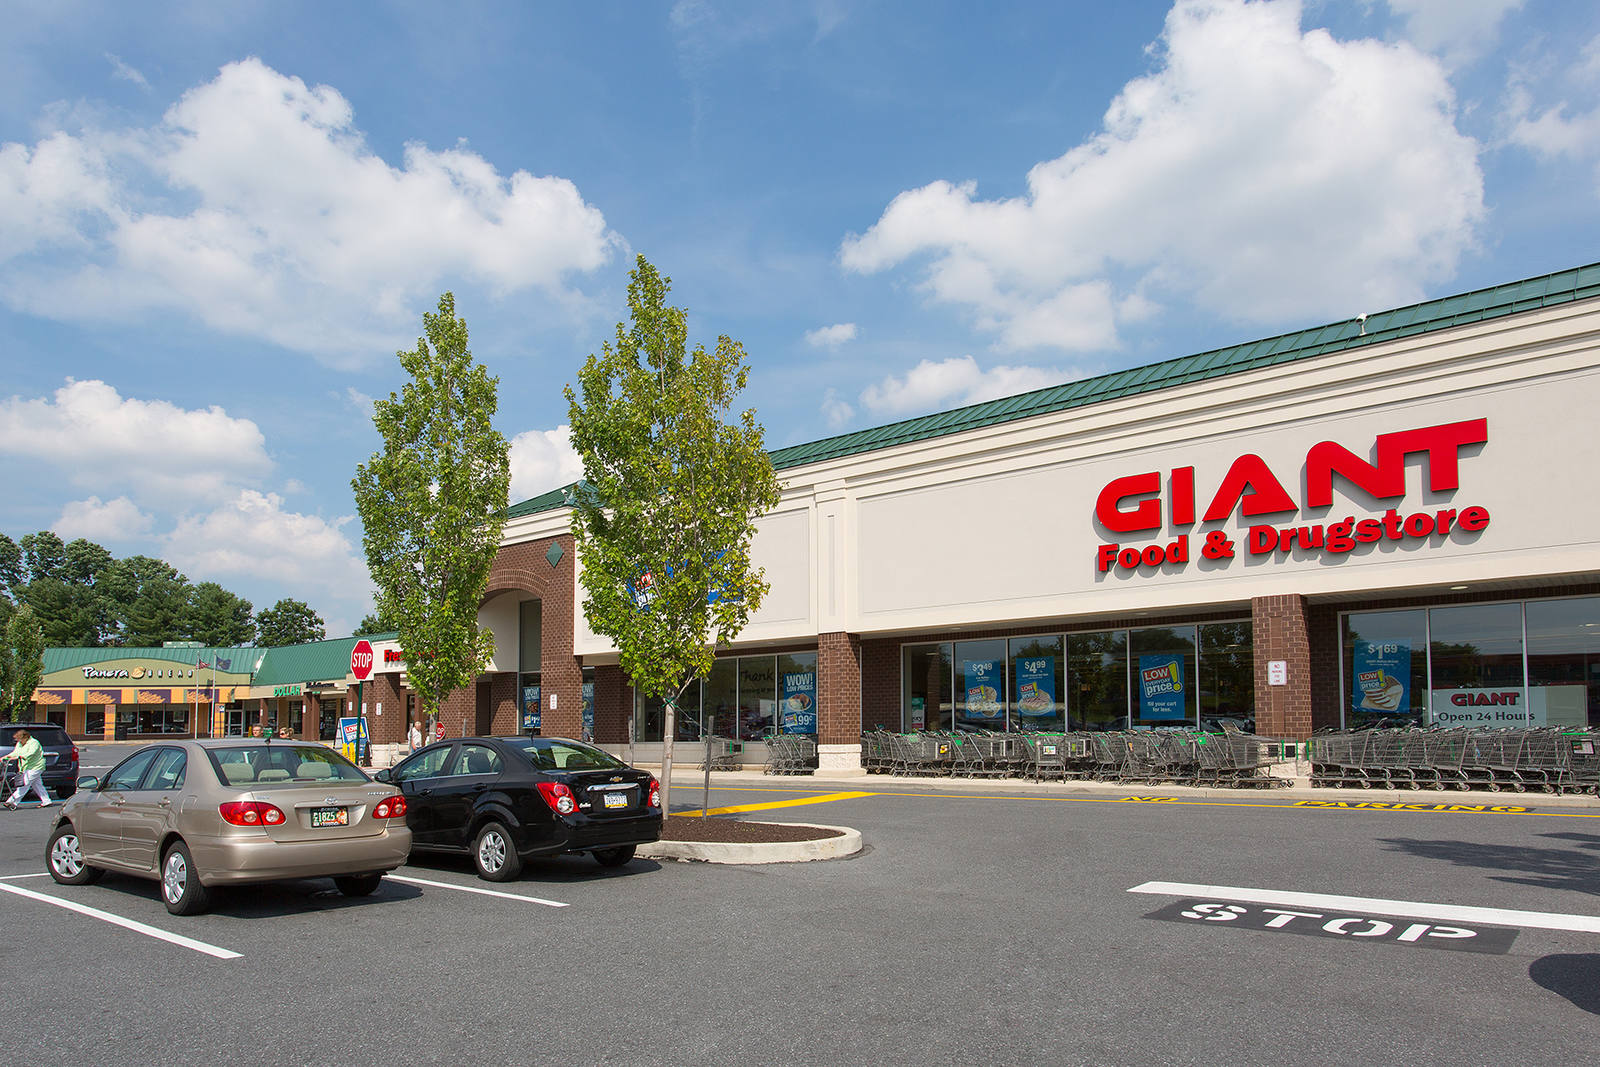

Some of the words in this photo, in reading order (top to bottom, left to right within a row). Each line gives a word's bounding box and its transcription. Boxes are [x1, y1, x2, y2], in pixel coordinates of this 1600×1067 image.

[1096, 418, 1488, 532] GIANT
[1098, 535, 1189, 571] Food
[1201, 530, 1235, 560] &
[1249, 505, 1490, 555] Drugstore
[353, 652, 372, 668] STOP
[82, 666, 129, 679] Panera
[147, 669, 194, 678] BREAD
[1144, 667, 1169, 681] LOW
[1359, 672, 1378, 681] LOW
[786, 673, 813, 687] WOW!
[273, 685, 301, 697] DOLLAR
[1451, 692, 1520, 706] GIANT
[1438, 712, 1473, 723] Open
[1476, 712, 1492, 721] 24
[1294, 800, 1528, 812] PARKING
[1180, 903, 1478, 942] STOP
